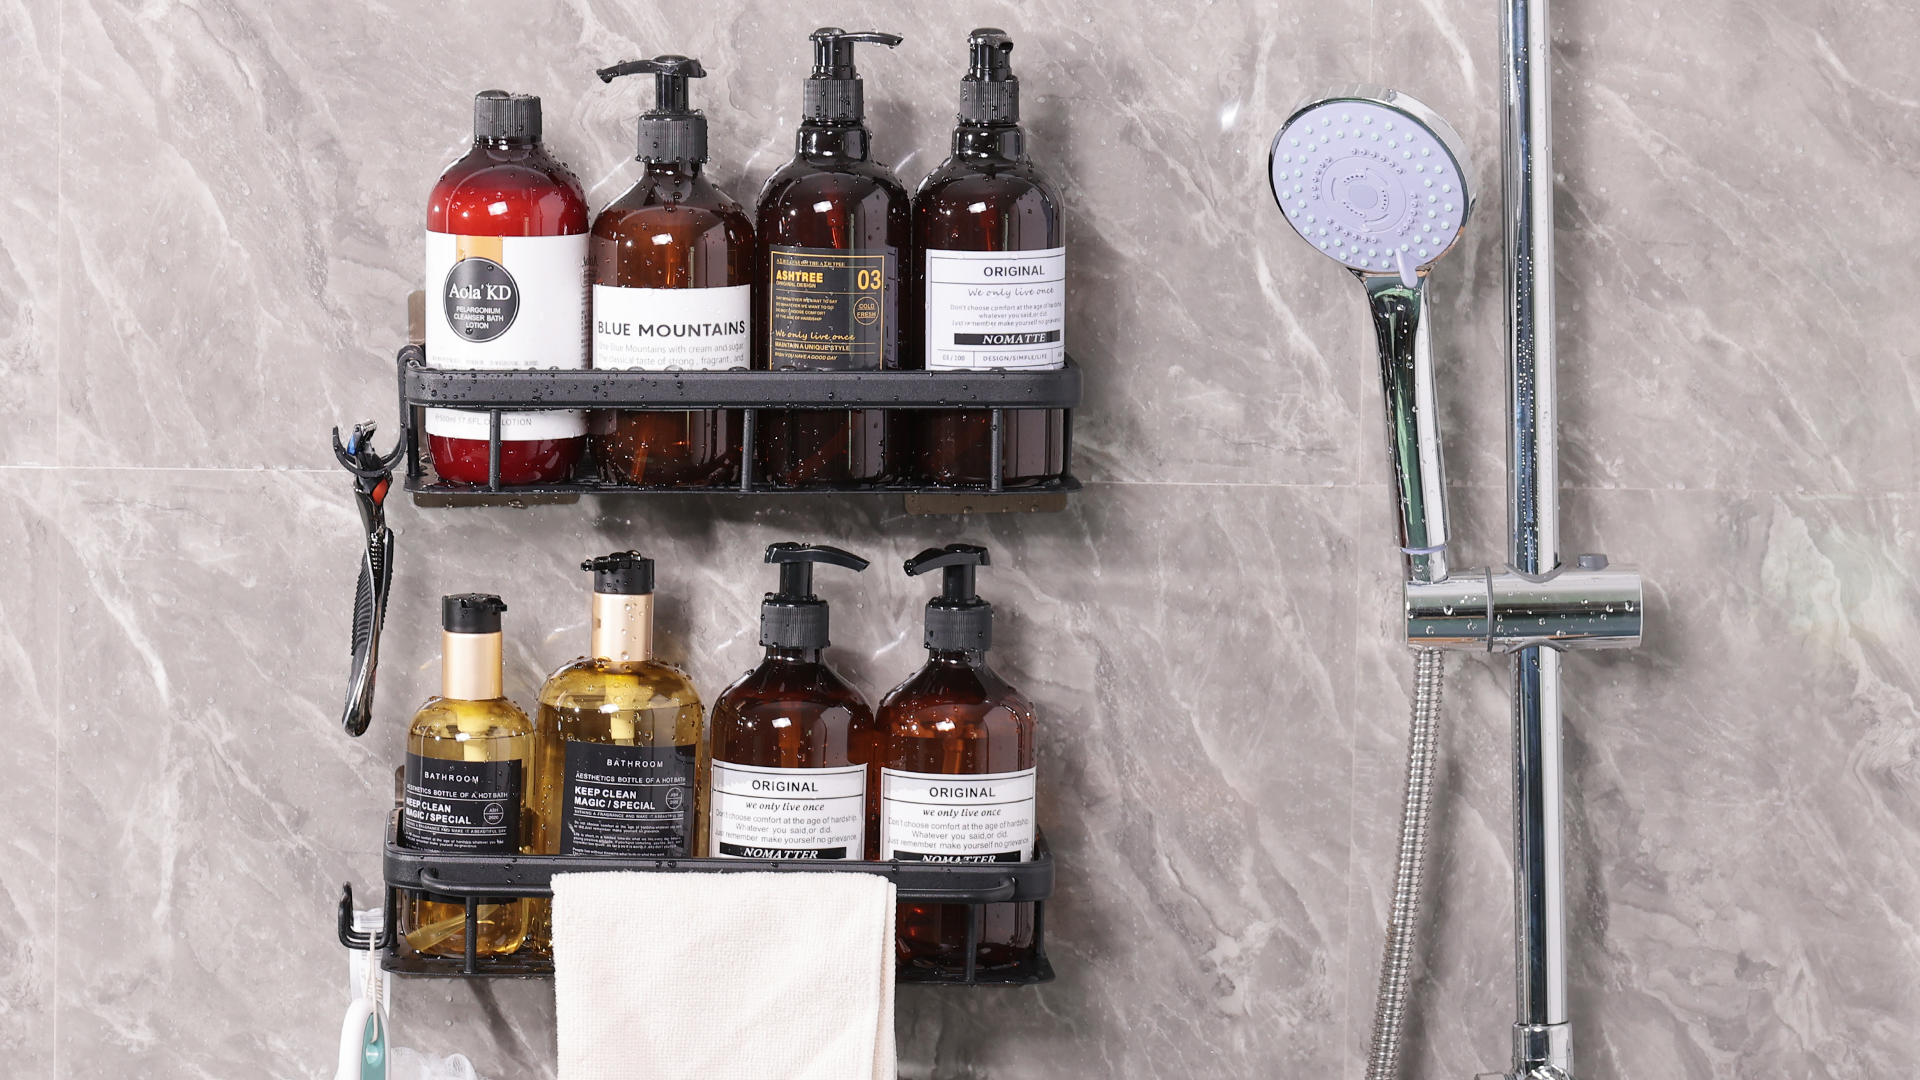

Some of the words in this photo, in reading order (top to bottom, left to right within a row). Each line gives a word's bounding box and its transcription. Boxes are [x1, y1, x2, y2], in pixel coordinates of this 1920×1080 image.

[983, 265, 1045, 277] ORIGINAL
[776, 270, 824, 283] ASHTREE
[857, 270, 881, 290] 03
[968, 288, 984, 297] We
[986, 289, 1011, 298] only
[1015, 288, 1035, 296] live
[1036, 287, 1054, 295] once
[456, 306, 501, 314] PELARGONIUM
[453, 313, 485, 321] CLEANSER
[486, 314, 504, 322] BATH
[1015, 319, 1038, 327] yourself
[598, 321, 631, 336] BLUE
[638, 321, 745, 337] MOUNTAINS
[775, 329, 786, 337] We
[787, 331, 808, 341] only
[810, 332, 830, 340] live
[982, 333, 1046, 345] NOMATTE
[626, 345, 666, 353] Mountains
[669, 345, 686, 353] with
[714, 344, 728, 352] and
[609, 356, 634, 364] classical
[658, 357, 666, 365] of
[734, 353, 744, 362] and
[982, 354, 1048, 362] DESIGN/SIMPLE/LIFE
[607, 759, 663, 768] BATHROOM
[424, 771, 479, 783] BATHROOM
[575, 773, 615, 783] AESTHETICS
[752, 780, 818, 792] ORIGINAL
[433, 790, 458, 798] BOTTLE
[574, 786, 601, 797] KEEP
[602, 789, 637, 799] CLEAN
[929, 787, 996, 798] ORIGINAL
[421, 801, 451, 813] CLEAN
[574, 797, 606, 808] MAGIC
[613, 801, 656, 810] SPECIAL
[759, 803, 780, 812] only
[782, 803, 801, 811] live
[406, 807, 425, 820] MAGIC
[430, 813, 471, 825] SPECIAL
[728, 813, 751, 821] choose
[753, 816, 781, 824] comfort
[792, 817, 804, 825] the
[806, 818, 821, 826] age
[937, 809, 959, 819] only
[961, 809, 979, 817] live
[736, 823, 769, 833] Whatever
[819, 826, 832, 834] did.
[904, 820, 929, 829] choose
[999, 821, 1006, 829] of
[725, 832, 758, 842] remember
[784, 836, 815, 845] yourself
[911, 830, 948, 839] Whatever
[888, 837, 899, 845] Just
[901, 840, 937, 849] remember
[939, 842, 961, 850] make
[963, 841, 993, 851] yourself
[743, 848, 818, 859] NOMATTER
